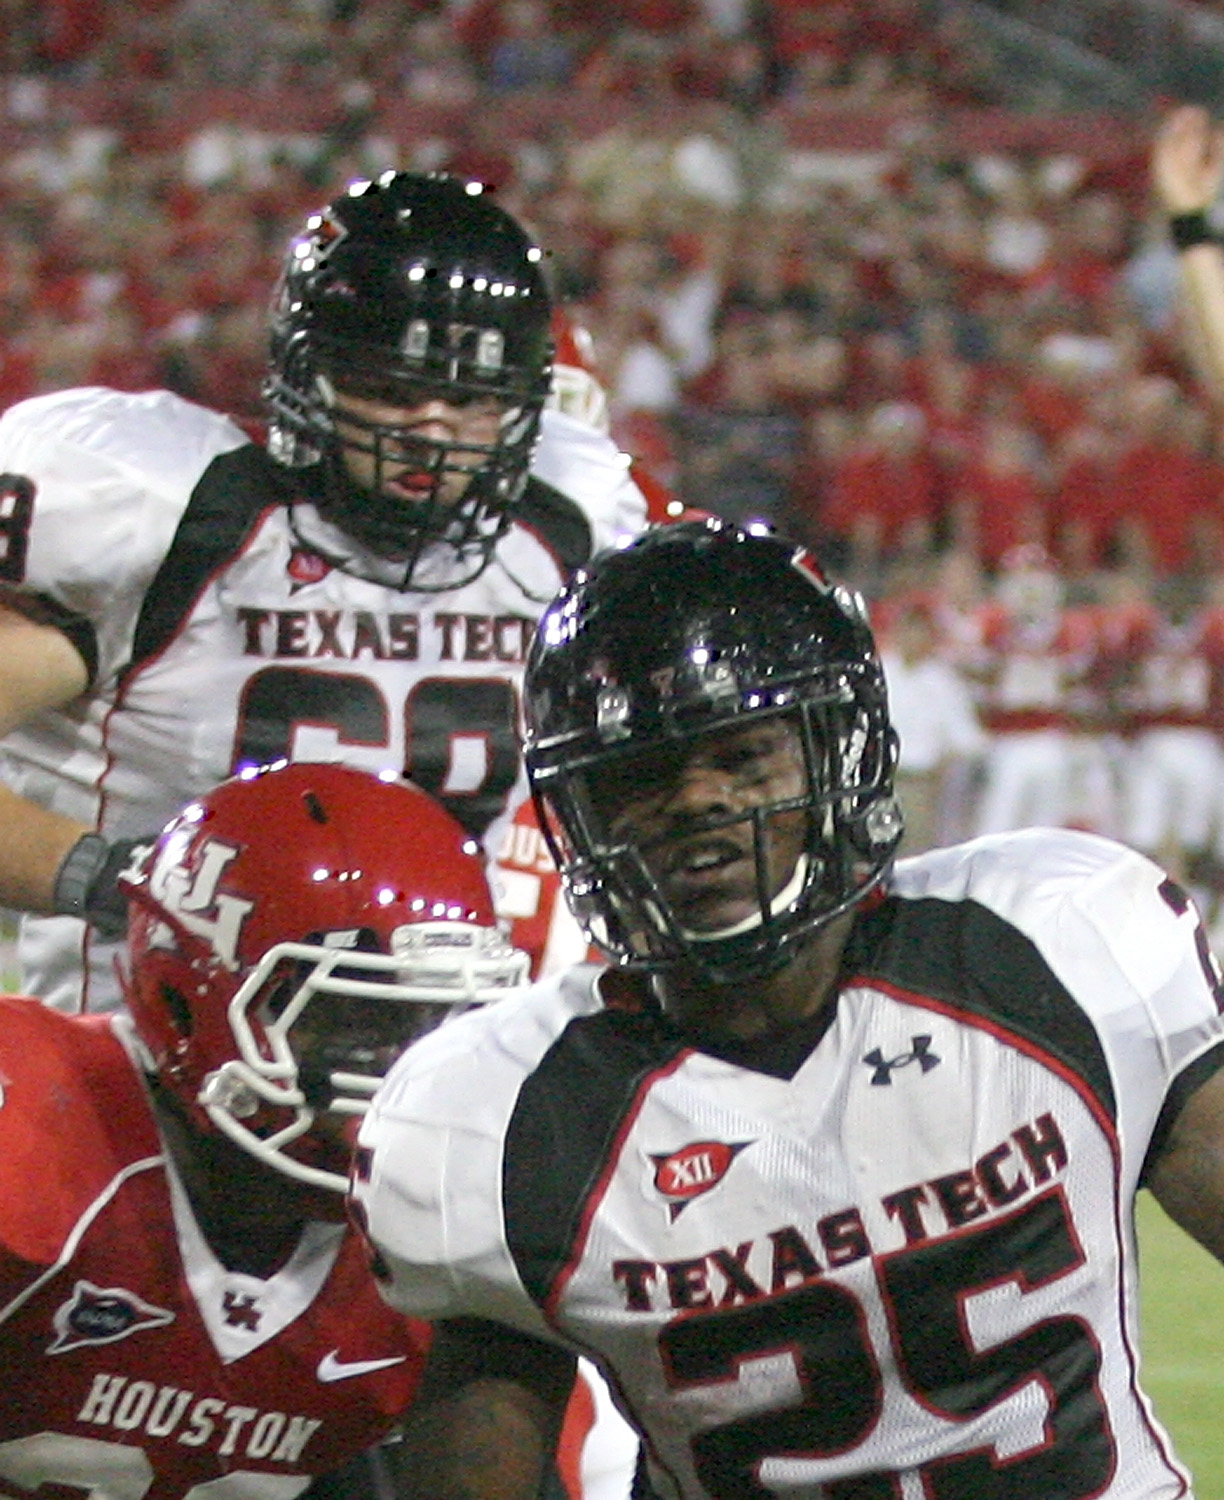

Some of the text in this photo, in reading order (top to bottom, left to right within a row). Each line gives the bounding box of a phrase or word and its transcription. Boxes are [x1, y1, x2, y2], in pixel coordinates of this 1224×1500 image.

[237, 608, 419, 661] TEXAS
[665, 1152, 715, 1190] XII
[612, 1111, 1070, 1312] TEXAS TECH
[77, 1373, 322, 1463] HOUSTON
